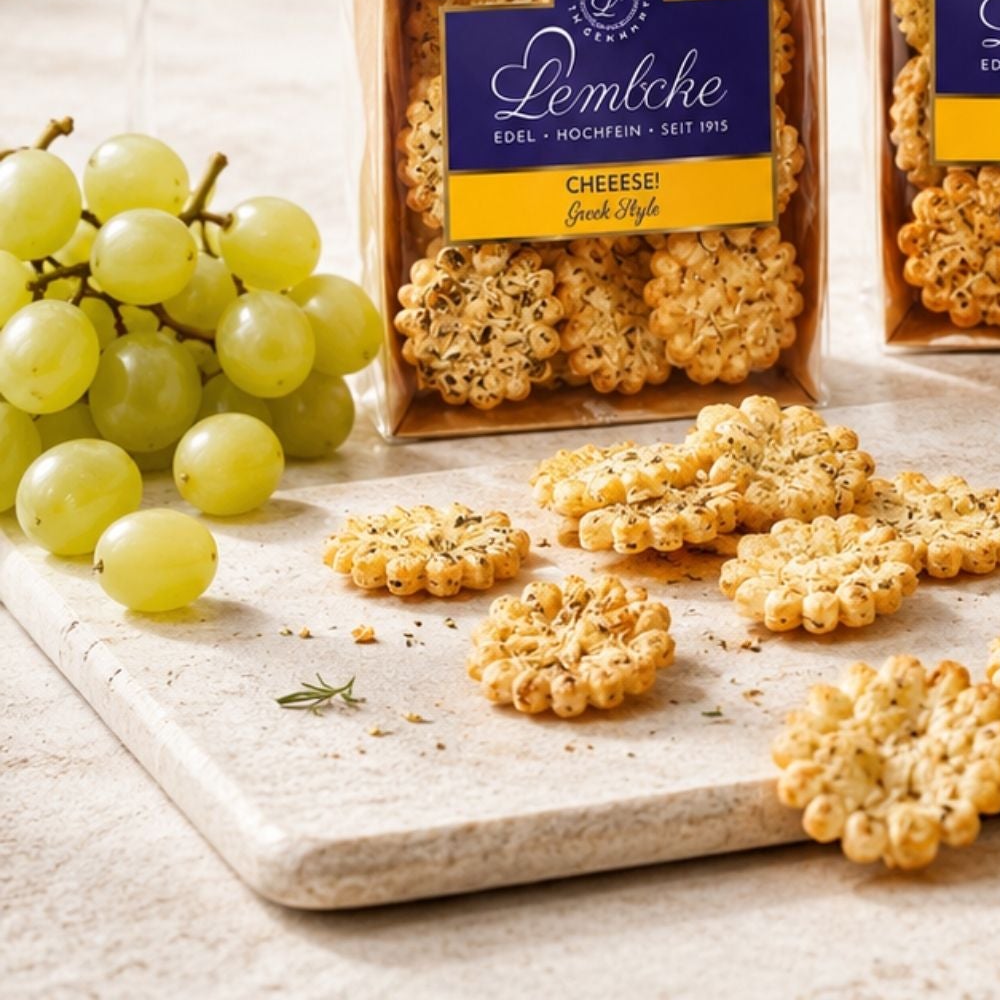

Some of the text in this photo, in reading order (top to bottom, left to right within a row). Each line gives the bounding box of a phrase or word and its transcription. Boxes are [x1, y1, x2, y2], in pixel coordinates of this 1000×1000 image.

[494, 119, 728, 144] EDEL HOCHFEIN SEIT 1915
[565, 171, 660, 195] CHEEESE!
[613, 196, 660, 227] Style
